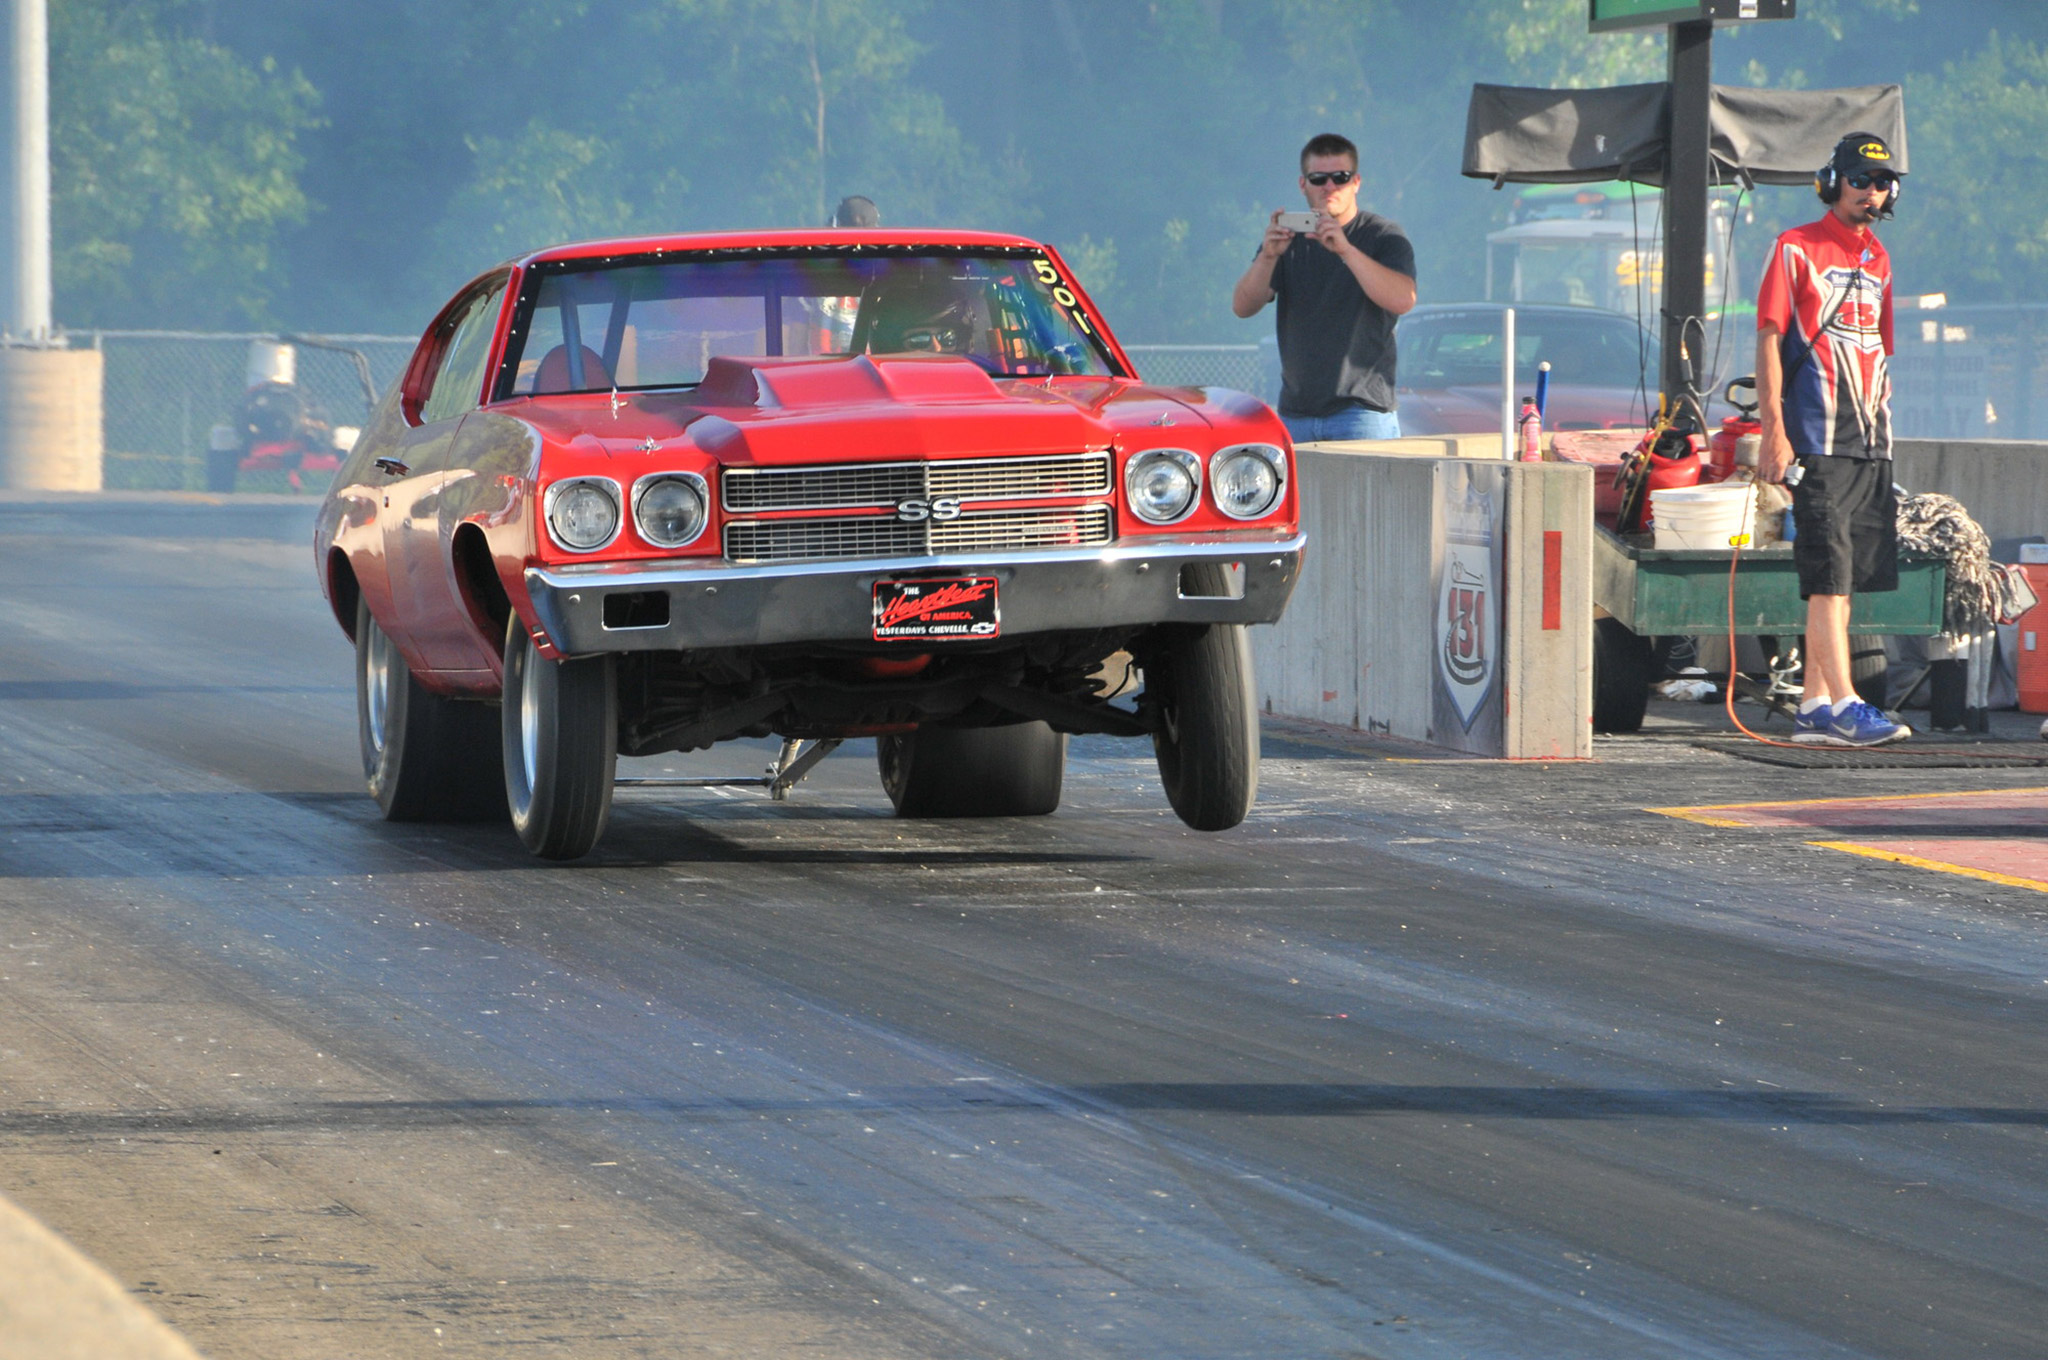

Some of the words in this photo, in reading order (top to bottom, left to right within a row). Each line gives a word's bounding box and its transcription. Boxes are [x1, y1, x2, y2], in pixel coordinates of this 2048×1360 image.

[1032, 259, 1091, 335] 501
[897, 497, 961, 522] SS
[903, 586, 920, 595] THE
[920, 612, 931, 621] OF
[1448, 586, 1485, 660] 131
